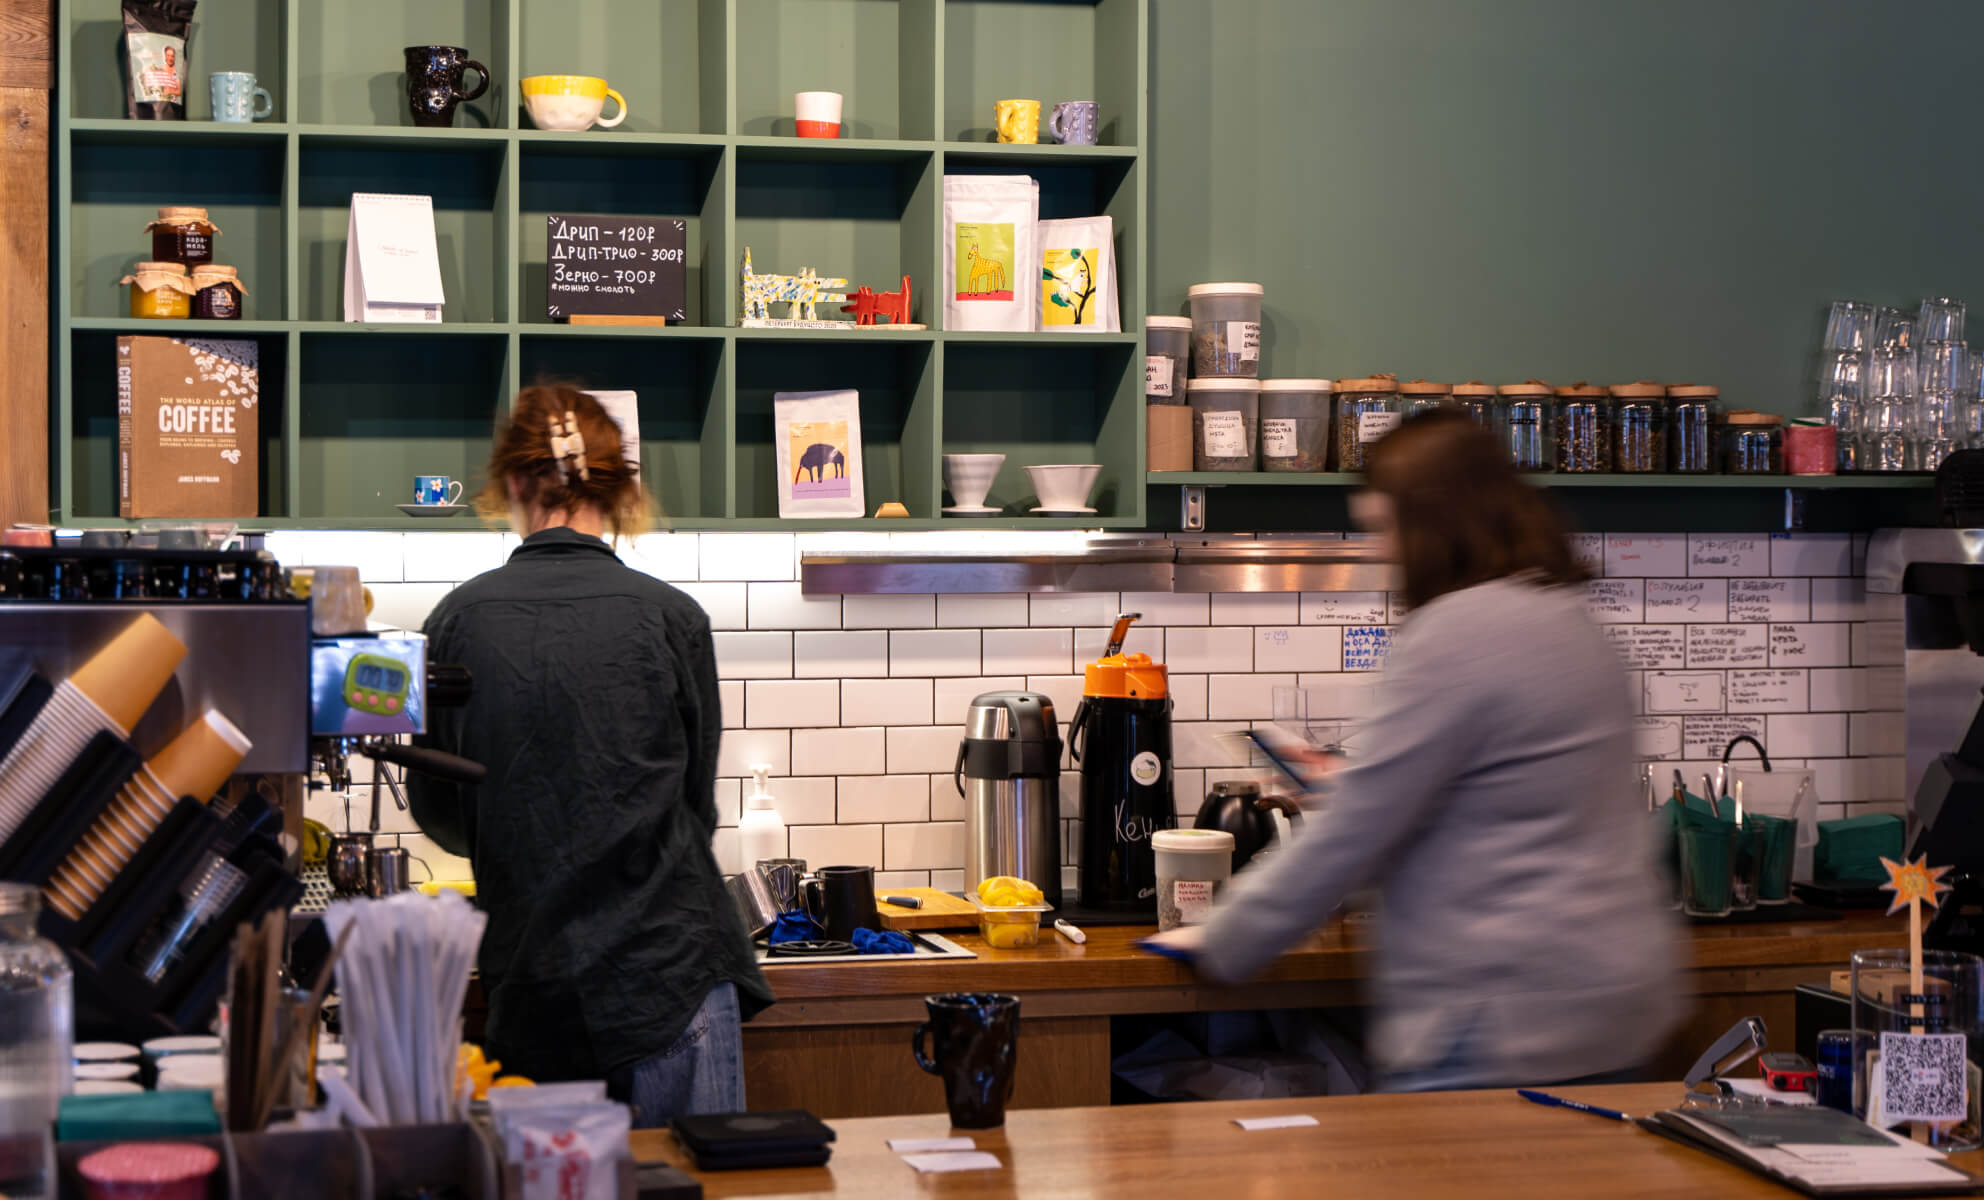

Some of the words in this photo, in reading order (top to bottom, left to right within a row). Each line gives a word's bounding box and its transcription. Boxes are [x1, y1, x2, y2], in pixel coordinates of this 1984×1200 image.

[554, 263, 600, 283] Зерно
[118, 366, 132, 415] COFFEE
[160, 397, 173, 405] THE
[175, 397, 202, 405] WORLD
[203, 398, 226, 406] ATLAS
[227, 398, 237, 406] OF
[159, 405, 237, 433] COFFEE
[1685, 593, 1701, 613] 2
